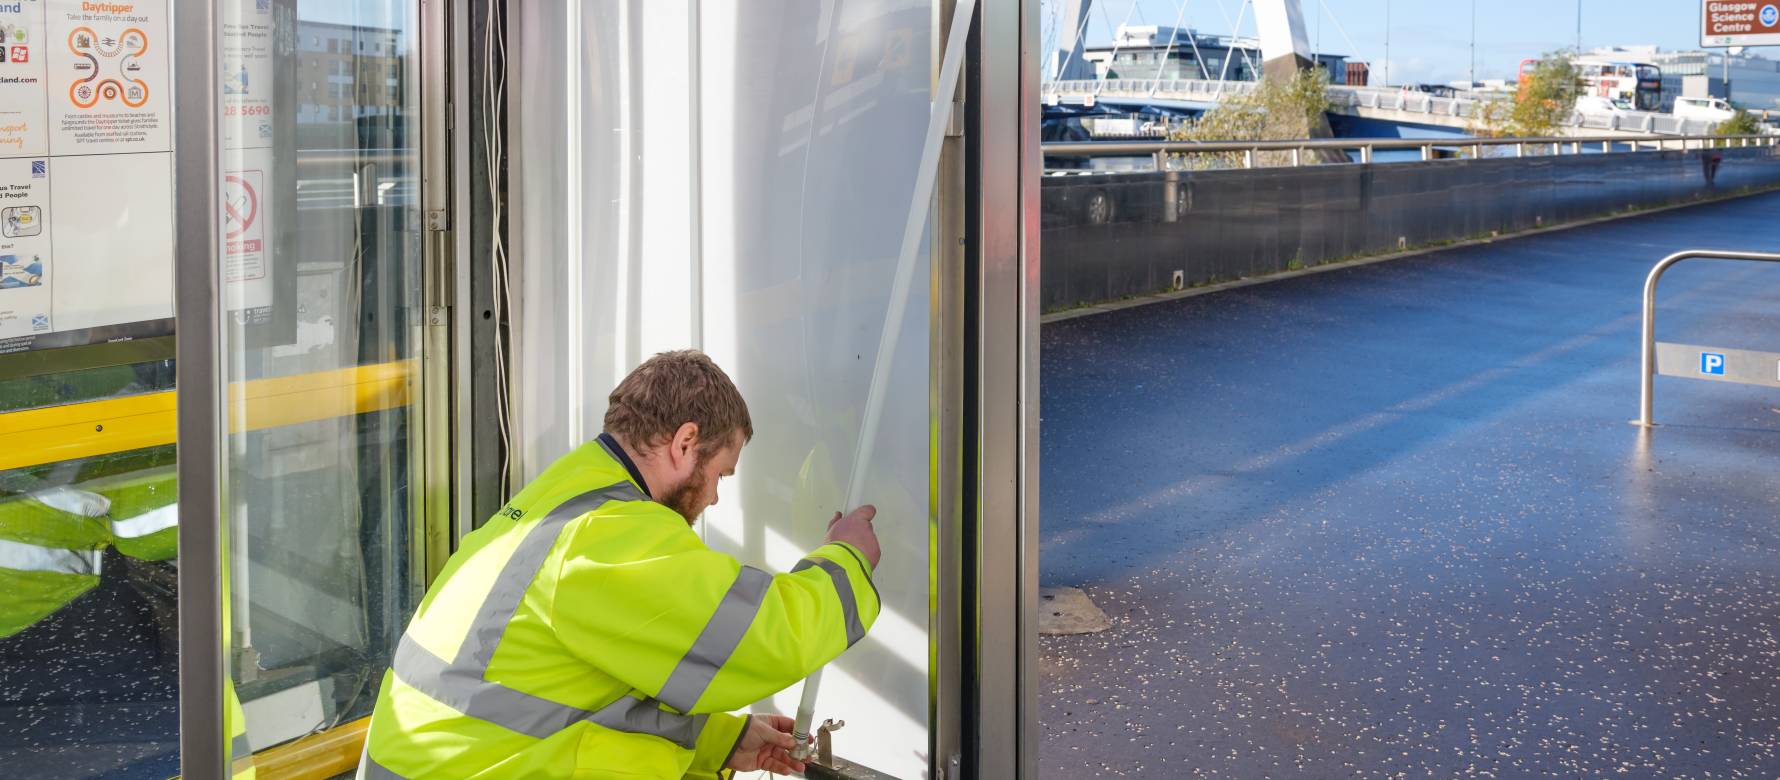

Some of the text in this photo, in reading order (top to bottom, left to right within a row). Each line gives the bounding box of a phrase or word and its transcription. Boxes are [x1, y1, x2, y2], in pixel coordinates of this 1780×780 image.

[82, 2, 133, 14] Daytripper
[1709, 3, 1757, 12] Glasgow
[94, 14, 112, 22] family
[1712, 13, 1754, 22] Science
[1713, 23, 1752, 32] Centre
[242, 106, 271, 116] 5690
[1706, 355, 1722, 373] P
